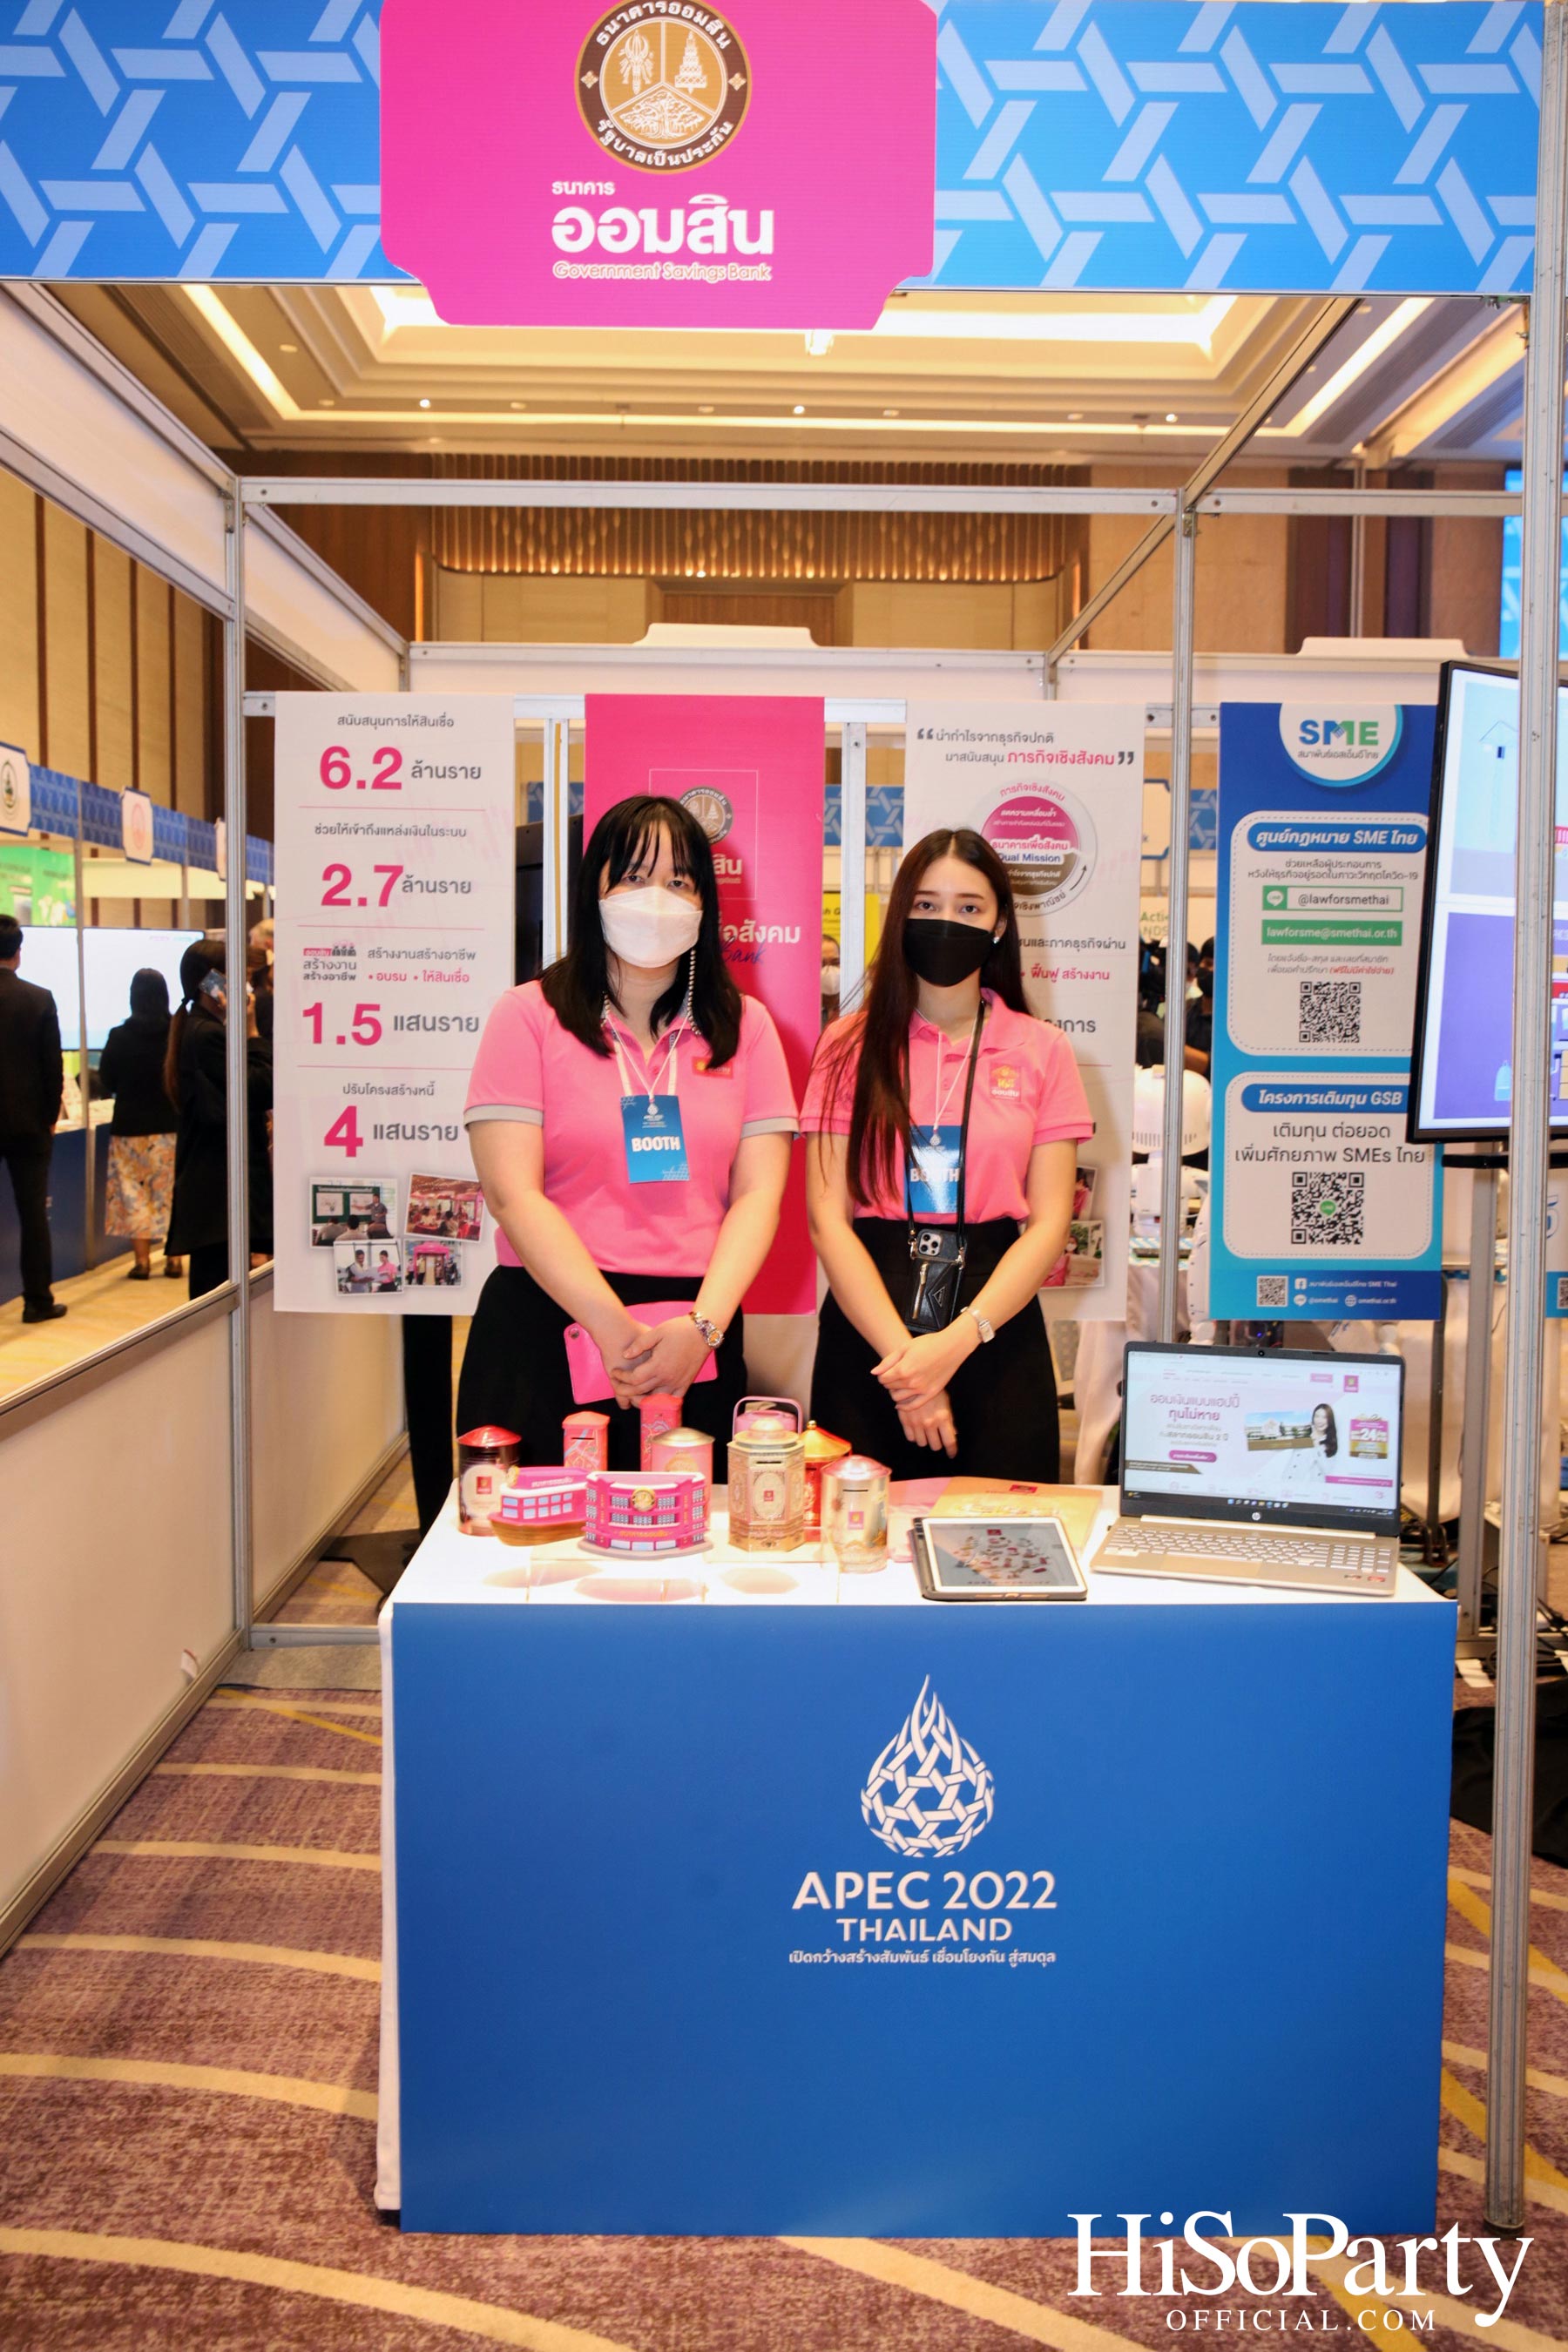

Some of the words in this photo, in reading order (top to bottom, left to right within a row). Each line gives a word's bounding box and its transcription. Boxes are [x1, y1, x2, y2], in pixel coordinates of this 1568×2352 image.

[596, 0, 732, 50] ธนาคารออมสิน
[597, 118, 735, 166] รัฐบาลเป็นประกัน
[551, 179, 615, 196] ธนาคาร
[551, 193, 774, 254] ออมสิน
[552, 261, 660, 280] Government
[663, 261, 727, 284] Savings
[727, 263, 772, 280] Bank
[337, 712, 455, 730] สนับสนุนการให้สินเชื่อ
[936, 729, 1055, 747] นำกำไรจากธุรกิจปกติ
[1298, 720, 1379, 746] SME
[320, 746, 403, 790] 6.2
[410, 759, 482, 781] ล้านราย
[945, 751, 1004, 767] มาสนับสนุน
[1007, 750, 1115, 767] ภารกิจเชิงสังคม
[314, 822, 467, 839] ช่วยให้เข้าถึงแหล่งเงินในระบบ
[1256, 828, 1350, 848] ศูนย์กฎหมาย
[1353, 830, 1389, 845] SME
[1390, 829, 1418, 845] ไทย
[1022, 854, 1061, 862] Mission
[321, 863, 404, 908] 2.7
[402, 874, 472, 895] ล้านราย
[1298, 894, 1389, 907] @lawforsmethai
[1267, 926, 1397, 940] lawforsme@smethai.or.th
[303, 958, 357, 970] สร้างงาน
[368, 948, 476, 962] สร้างงานสร้างอาชีพ
[376, 971, 407, 982] อบรม
[422, 969, 470, 983] ให้สินเชื่อ
[1031, 964, 1058, 983] ฟื้นฟู
[1062, 967, 1110, 981] สร้างงาน
[302, 1003, 382, 1046] 1.5
[394, 1013, 480, 1033] แสนราย
[343, 1080, 435, 1097] ปรับโครงสร้างหนี้
[1259, 1089, 1367, 1110] โครงการเติมทุน
[1370, 1091, 1403, 1105] GSB
[324, 1105, 363, 1158] 4
[373, 1123, 459, 1142] แสนราย
[1273, 1122, 1327, 1140] เติมทุน
[1332, 1123, 1391, 1139] ต่อยอด
[631, 1136, 681, 1152] BOOTH
[1235, 1143, 1337, 1164] เพิ่มศักยภาพ
[1342, 1147, 1392, 1164] SMEs
[1396, 1146, 1425, 1164] ไทย
[792, 1871, 931, 1910] APEC
[943, 1870, 1058, 1910] 2022
[836, 1918, 1013, 1942] THAILAND
[789, 1949, 929, 1963] เปิดกว้างสร้างสัมพันธ์
[932, 1946, 1006, 1963] เชื่อมโยงกัน
[1008, 1949, 1057, 1969] สู่สมดุล
